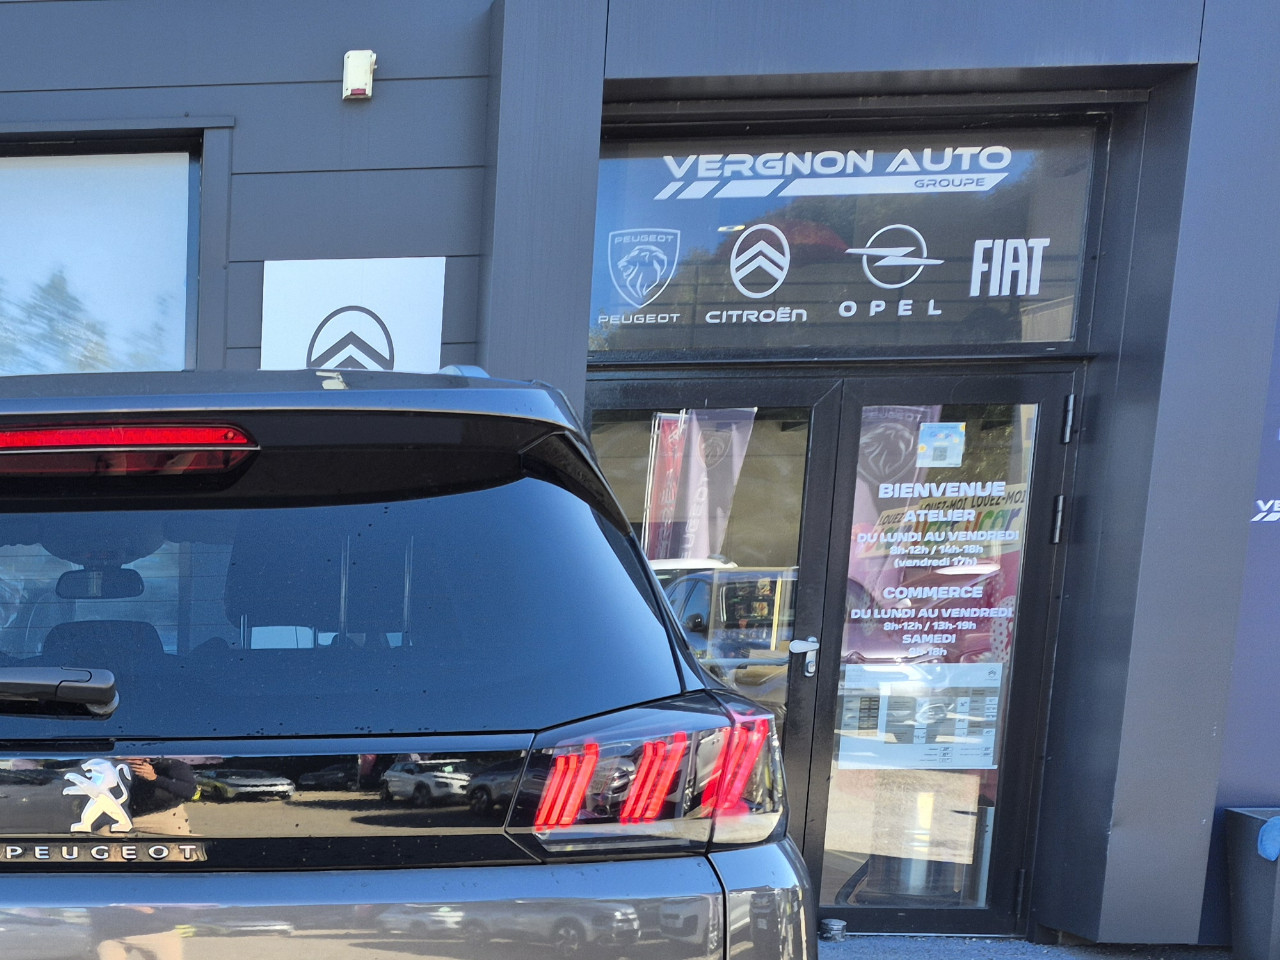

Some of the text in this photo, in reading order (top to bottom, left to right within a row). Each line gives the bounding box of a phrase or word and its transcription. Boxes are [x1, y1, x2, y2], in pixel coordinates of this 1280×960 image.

[663, 145, 1012, 179] VERGNON AUTO
[914, 177, 986, 188] GROUPE
[615, 234, 674, 244] PEUGEOT
[969, 237, 1051, 298] FIAT
[838, 299, 943, 318] OPEL
[598, 313, 681, 324] PEUGEOT
[878, 481, 1006, 498] BIENVENUE
[904, 509, 976, 522] ATELIER
[857, 532, 878, 543] DU
[880, 532, 922, 542] LUNDI
[924, 531, 946, 542] AU
[948, 530, 1020, 541] VENDREDI
[883, 586, 984, 599] COMMERCE
[851, 607, 1014, 619] DU LUNDI AU VENDREDI
[902, 633, 957, 644] SAMEDI
[5, 845, 197, 860] PEUGEOT
